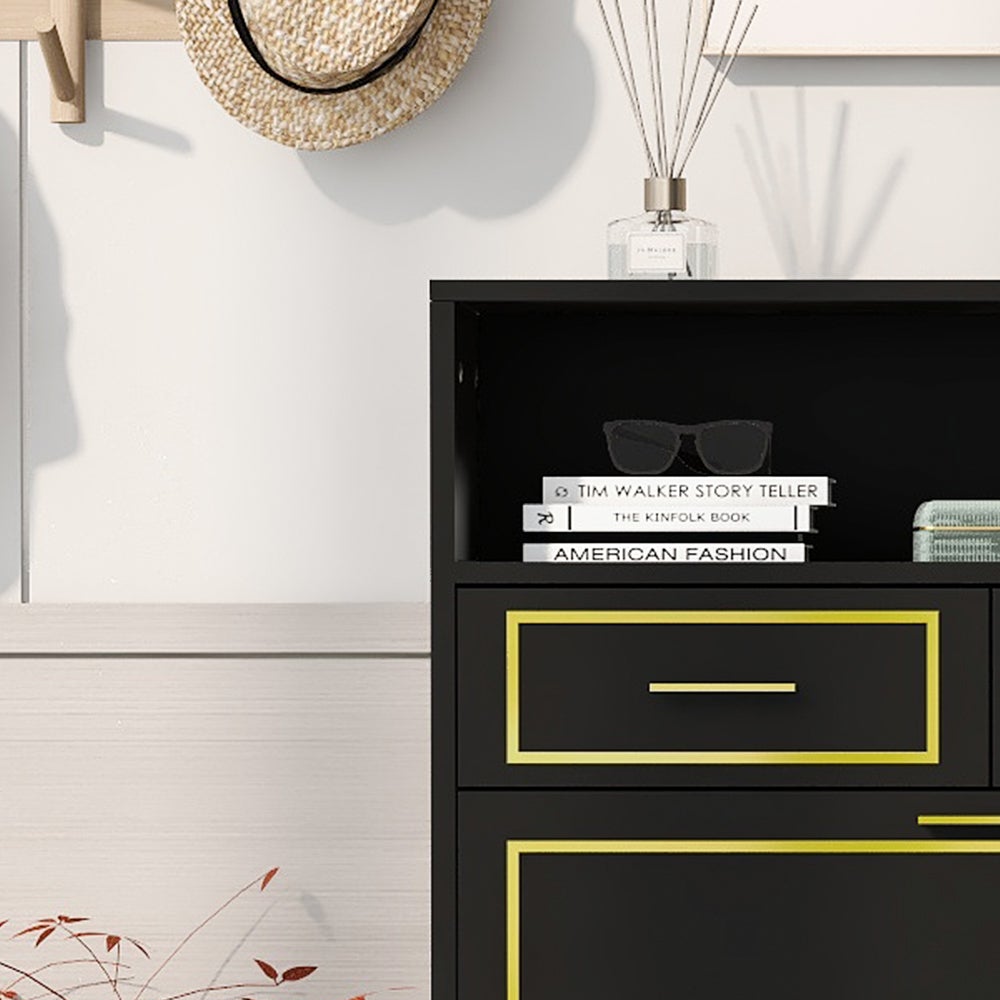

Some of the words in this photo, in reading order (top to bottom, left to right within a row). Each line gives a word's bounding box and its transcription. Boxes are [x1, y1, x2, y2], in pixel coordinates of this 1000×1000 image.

[577, 484, 608, 498] TIM
[615, 484, 689, 498] WALKER
[695, 484, 753, 498] STORY
[759, 484, 818, 498] TELLER
[614, 512, 638, 523] THE
[645, 512, 705, 523] KINFOLK
[710, 512, 750, 523] BOOK
[553, 547, 677, 561] AMERICAN
[686, 547, 786, 561] FASHION
